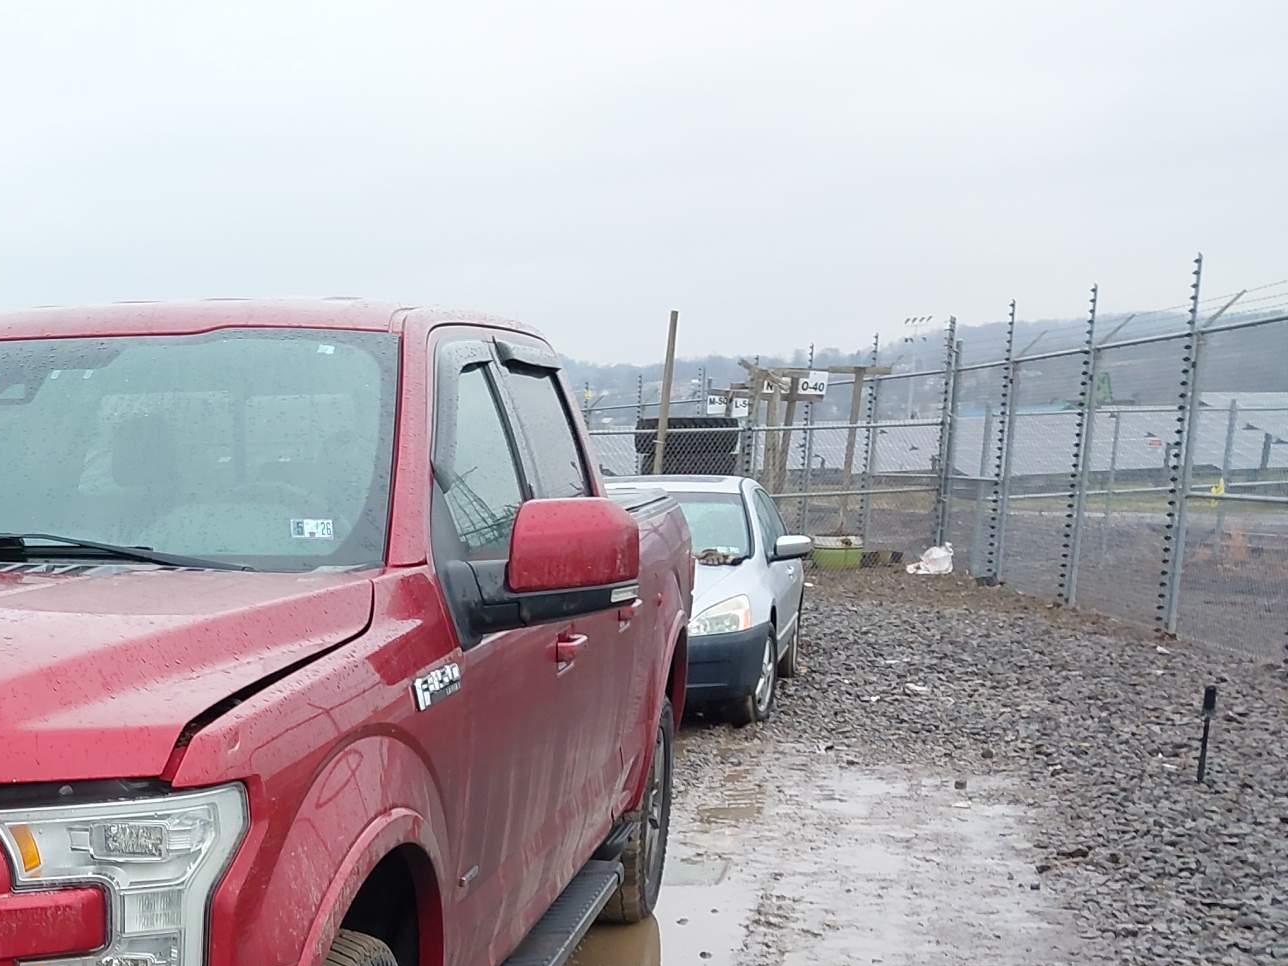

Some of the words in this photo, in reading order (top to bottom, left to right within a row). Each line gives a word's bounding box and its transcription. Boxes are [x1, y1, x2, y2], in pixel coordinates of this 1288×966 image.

[801, 381, 825, 392] O-40
[734, 400, 748, 408] L-5
[320, 521, 331, 536] 26
